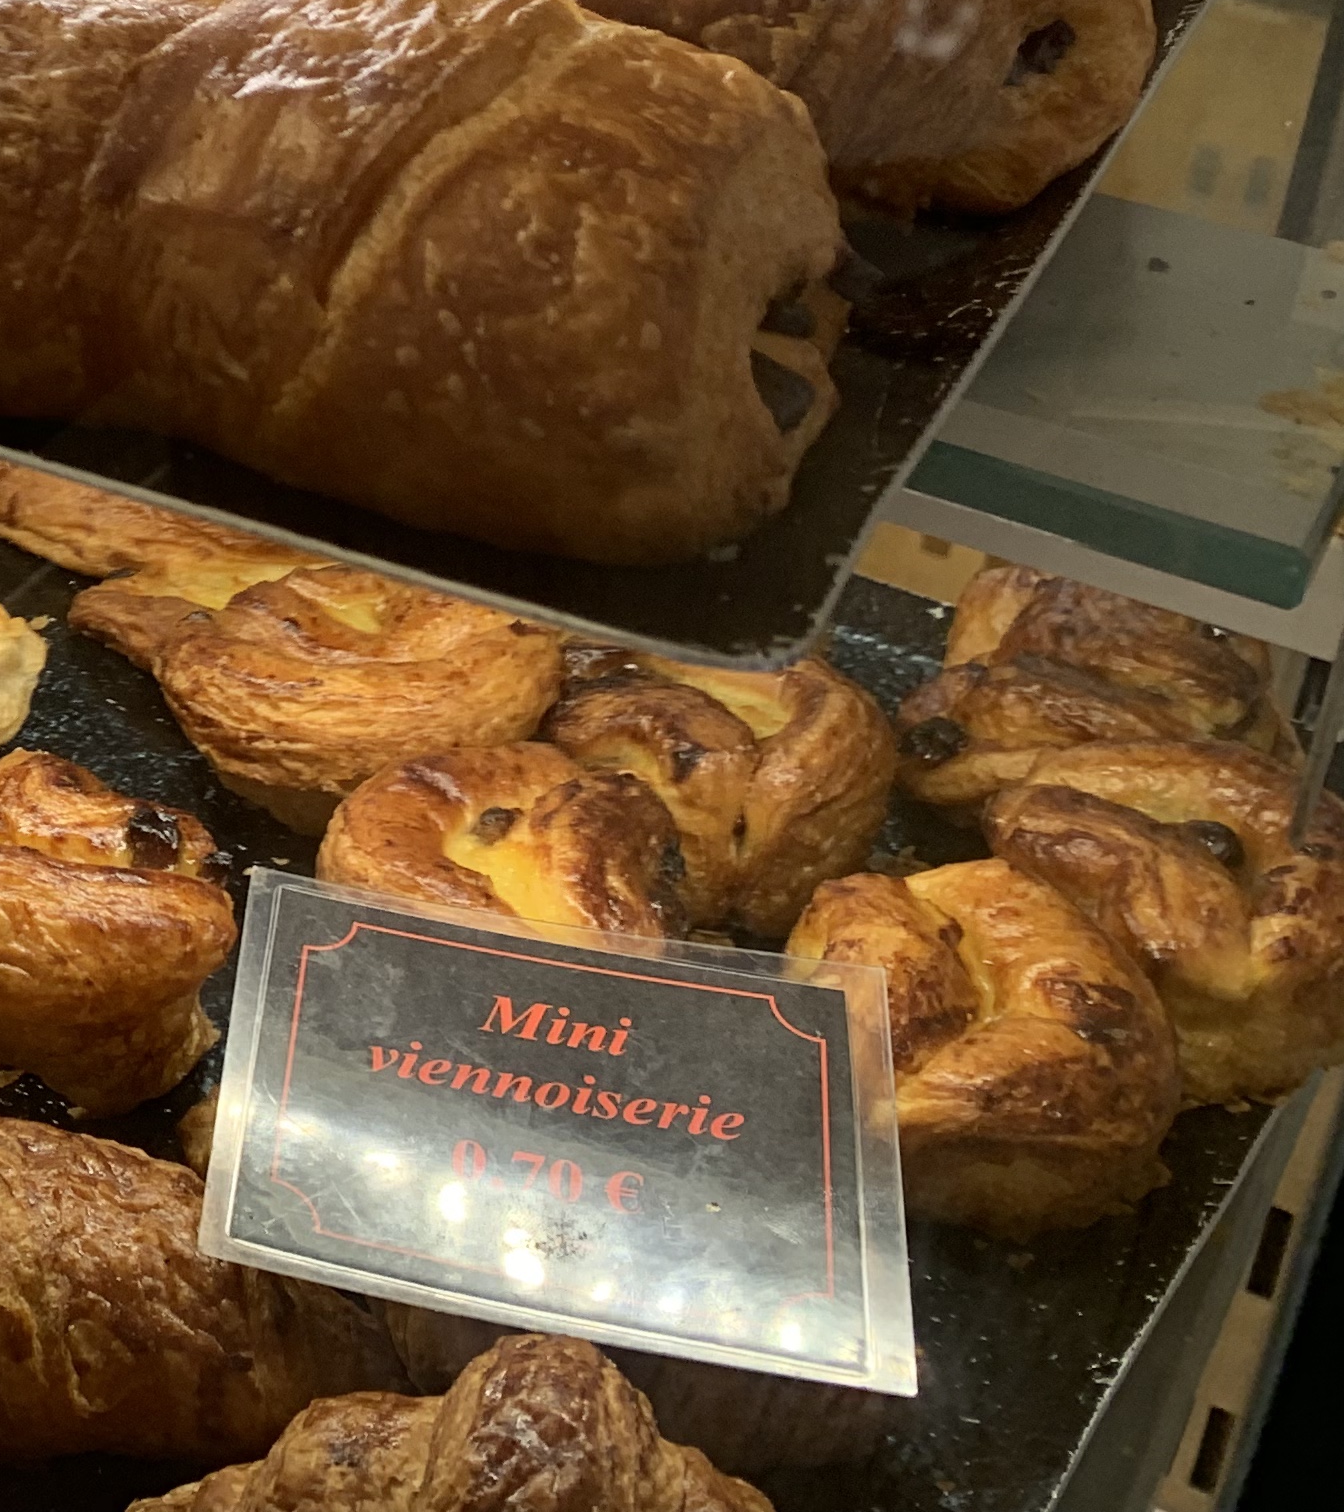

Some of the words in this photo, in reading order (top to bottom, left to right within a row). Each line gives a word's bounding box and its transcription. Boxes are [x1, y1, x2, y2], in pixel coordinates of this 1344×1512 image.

[478, 994, 633, 1057] Mini
[367, 1040, 746, 1141] viennoiserie
[450, 1139, 584, 1205] 0.70
[604, 1170, 645, 1214] €
